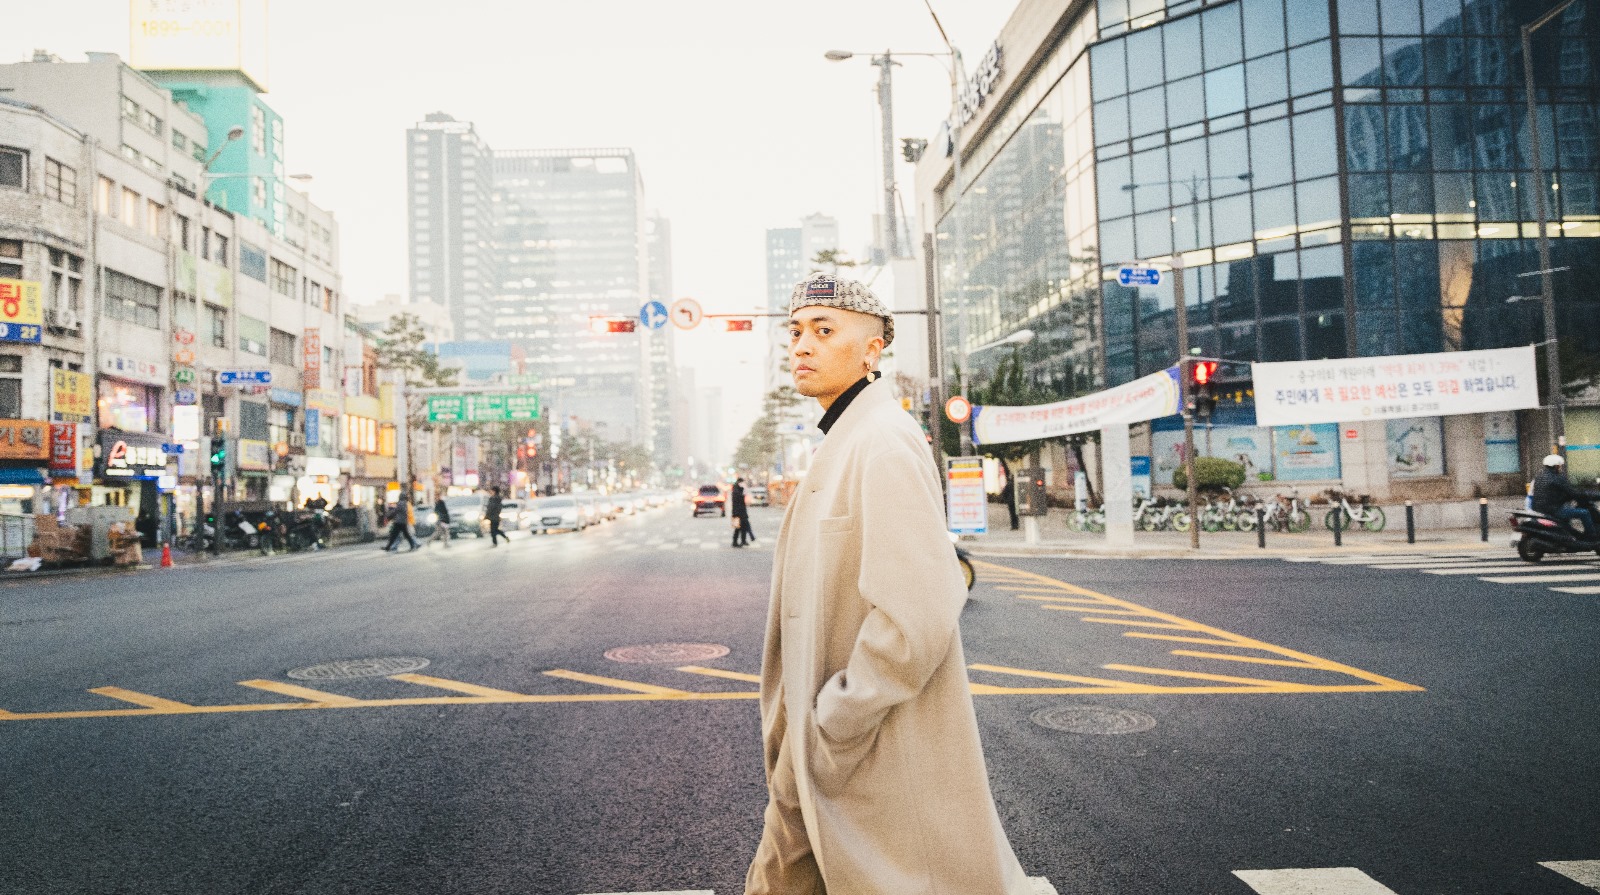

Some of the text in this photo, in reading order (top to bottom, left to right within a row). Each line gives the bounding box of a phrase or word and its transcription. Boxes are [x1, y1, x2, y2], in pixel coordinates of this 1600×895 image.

[1276, 388, 1319, 405] 주민에게
[1338, 384, 1371, 402] 필요한
[1375, 381, 1408, 400] 예산은
[1413, 380, 1434, 396] 모두
[1437, 379, 1460, 395] 의결
